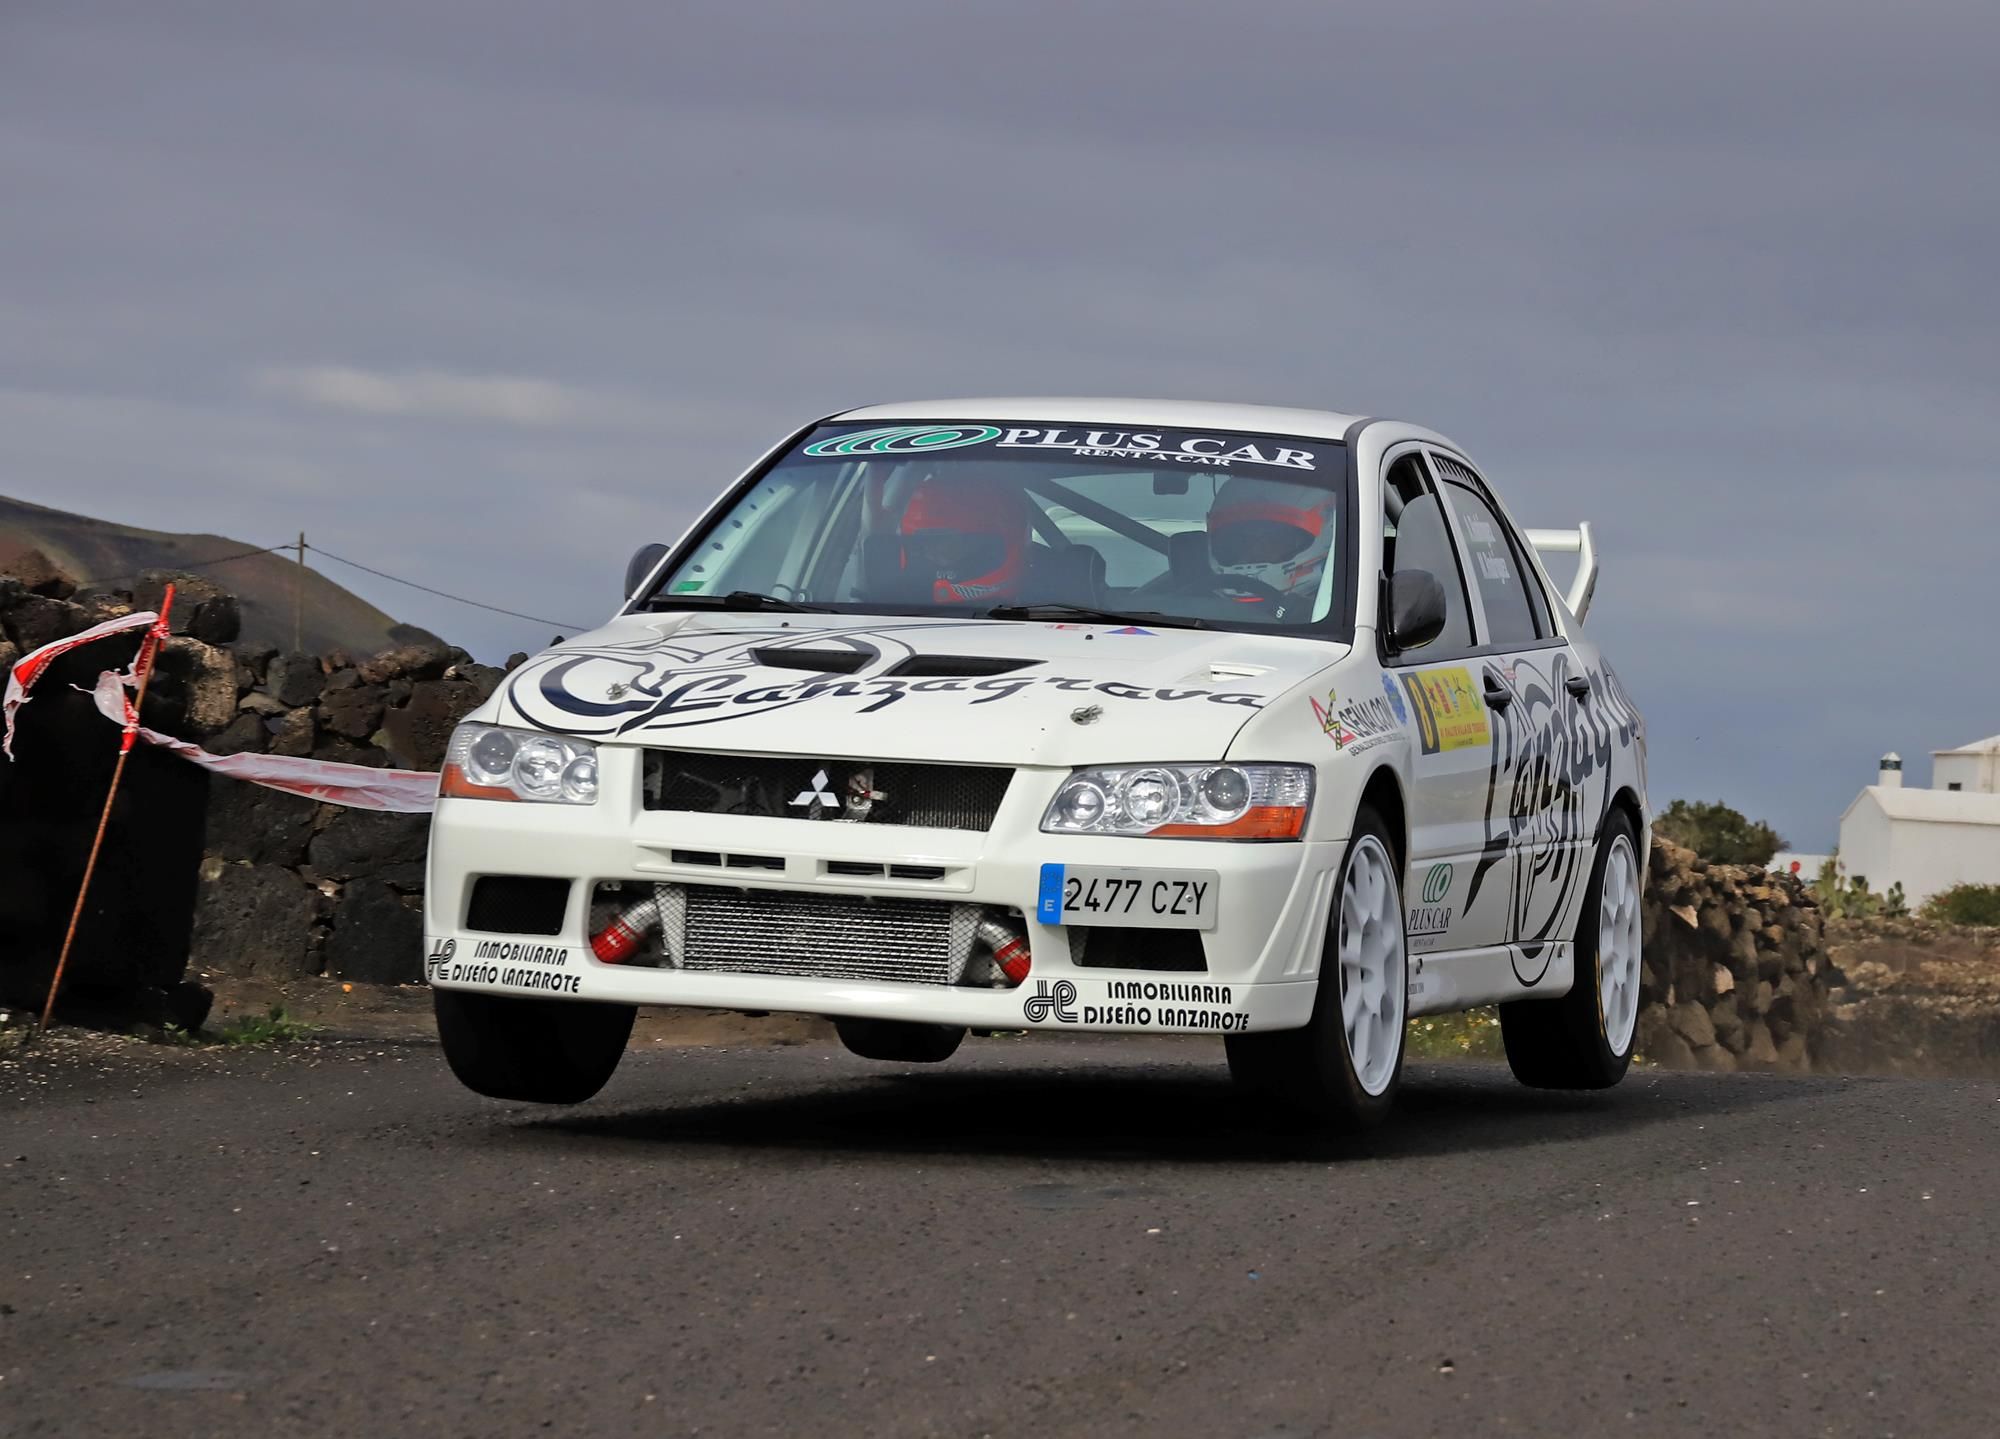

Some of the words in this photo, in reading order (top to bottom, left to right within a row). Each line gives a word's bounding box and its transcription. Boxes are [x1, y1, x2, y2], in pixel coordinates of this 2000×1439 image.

[998, 428, 1162, 450] PLUS
[1181, 438, 1316, 468] CAR
[1073, 447, 1147, 459] RENT
[1150, 452, 1169, 460] A
[1175, 455, 1231, 467] CAR
[615, 674, 1263, 737] Lanzagrava
[1407, 676, 1434, 749] 8
[1043, 898, 1055, 912] E
[1064, 877, 1142, 913] 2477
[1151, 880, 1208, 915] CZY
[1408, 907, 1432, 931] PLUS
[1432, 907, 1452, 929] CAR
[474, 941, 568, 966] INMOBILIARIA
[452, 961, 498, 984] DISEÑO
[501, 967, 582, 993] LANZAROTE
[1107, 981, 1232, 1005] INMOBILIARIA
[1083, 1002, 1152, 1025] DISEÑO
[1158, 1007, 1250, 1031] LANZAROTE
